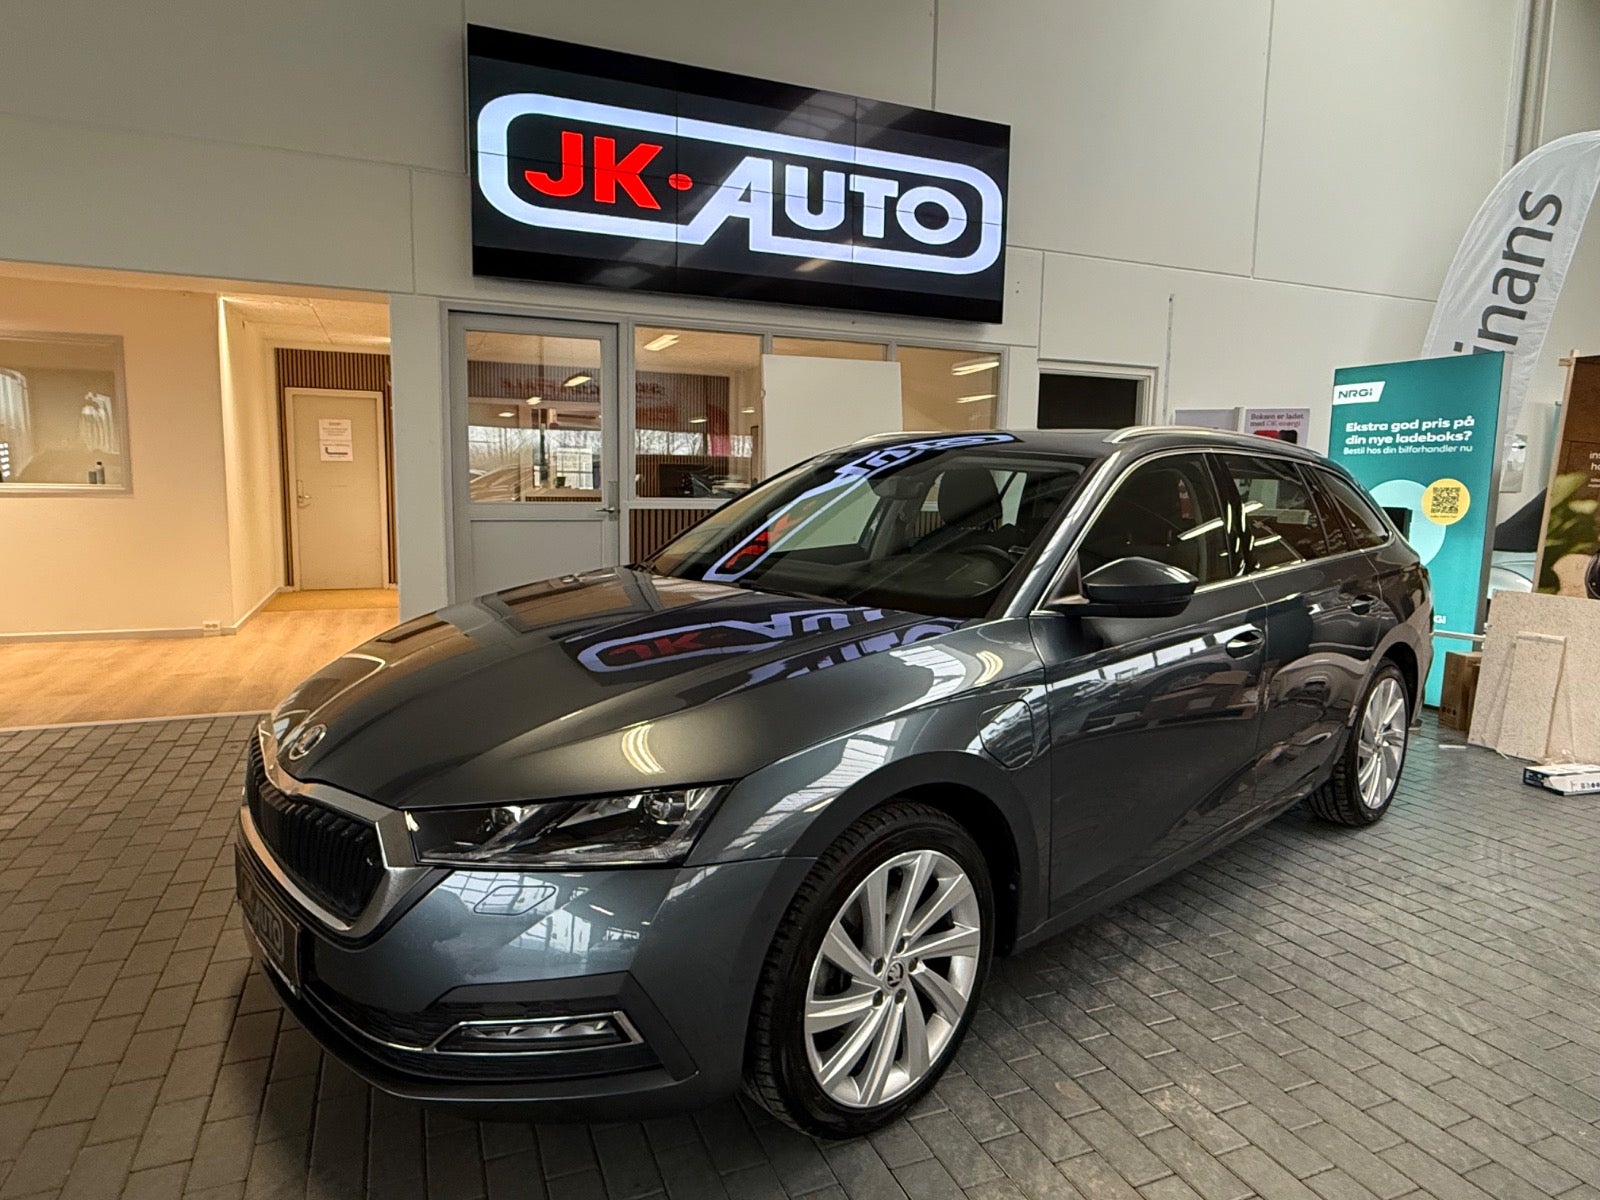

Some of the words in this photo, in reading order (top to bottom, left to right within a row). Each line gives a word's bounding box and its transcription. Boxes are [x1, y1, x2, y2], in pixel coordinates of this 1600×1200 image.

[690, 155, 968, 250] AUTO
[1345, 421, 1388, 432] Ekstra
[1390, 419, 1419, 433] god
[1421, 418, 1450, 431] pris
[1453, 415, 1475, 429] på
[1345, 434, 1366, 445] din
[1368, 436, 1393, 446] nye
[1396, 431, 1472, 443] ladeboks?
[1343, 447, 1365, 455] Bestil
[1366, 446, 1381, 454] hos
[1382, 446, 1396, 454] din
[1398, 445, 1458, 453] bilforhandler
